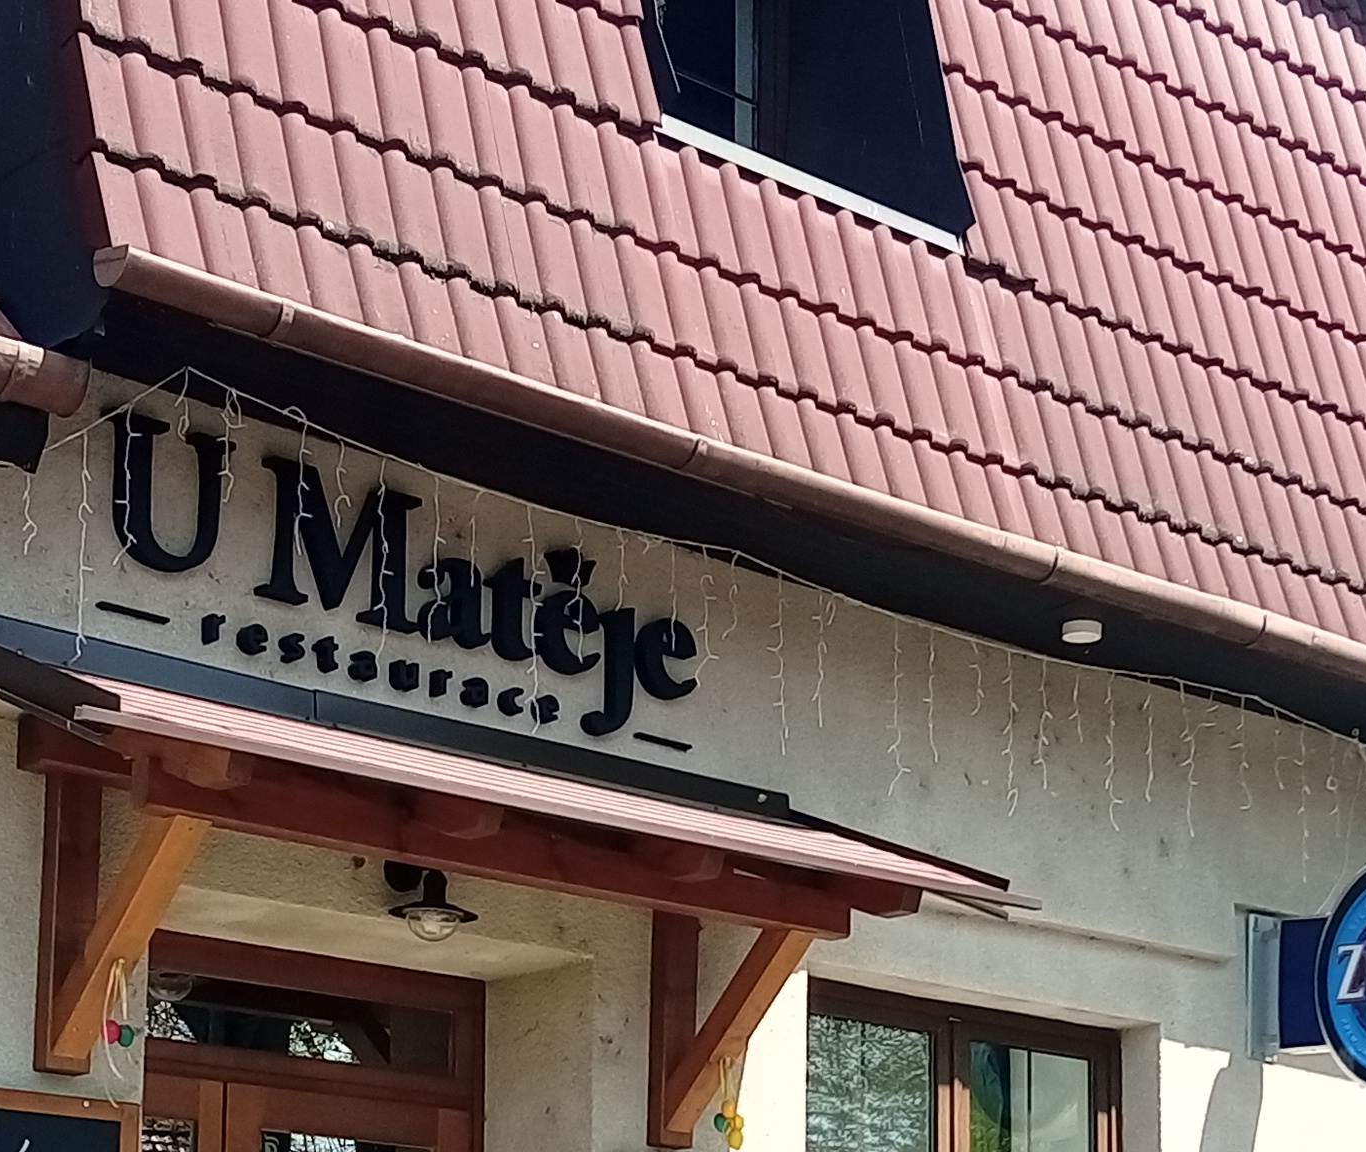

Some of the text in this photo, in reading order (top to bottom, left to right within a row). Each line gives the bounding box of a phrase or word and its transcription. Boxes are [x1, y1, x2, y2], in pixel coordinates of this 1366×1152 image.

[101, 411, 698, 736] U Matěje
[200, 609, 562, 725] restaurace
